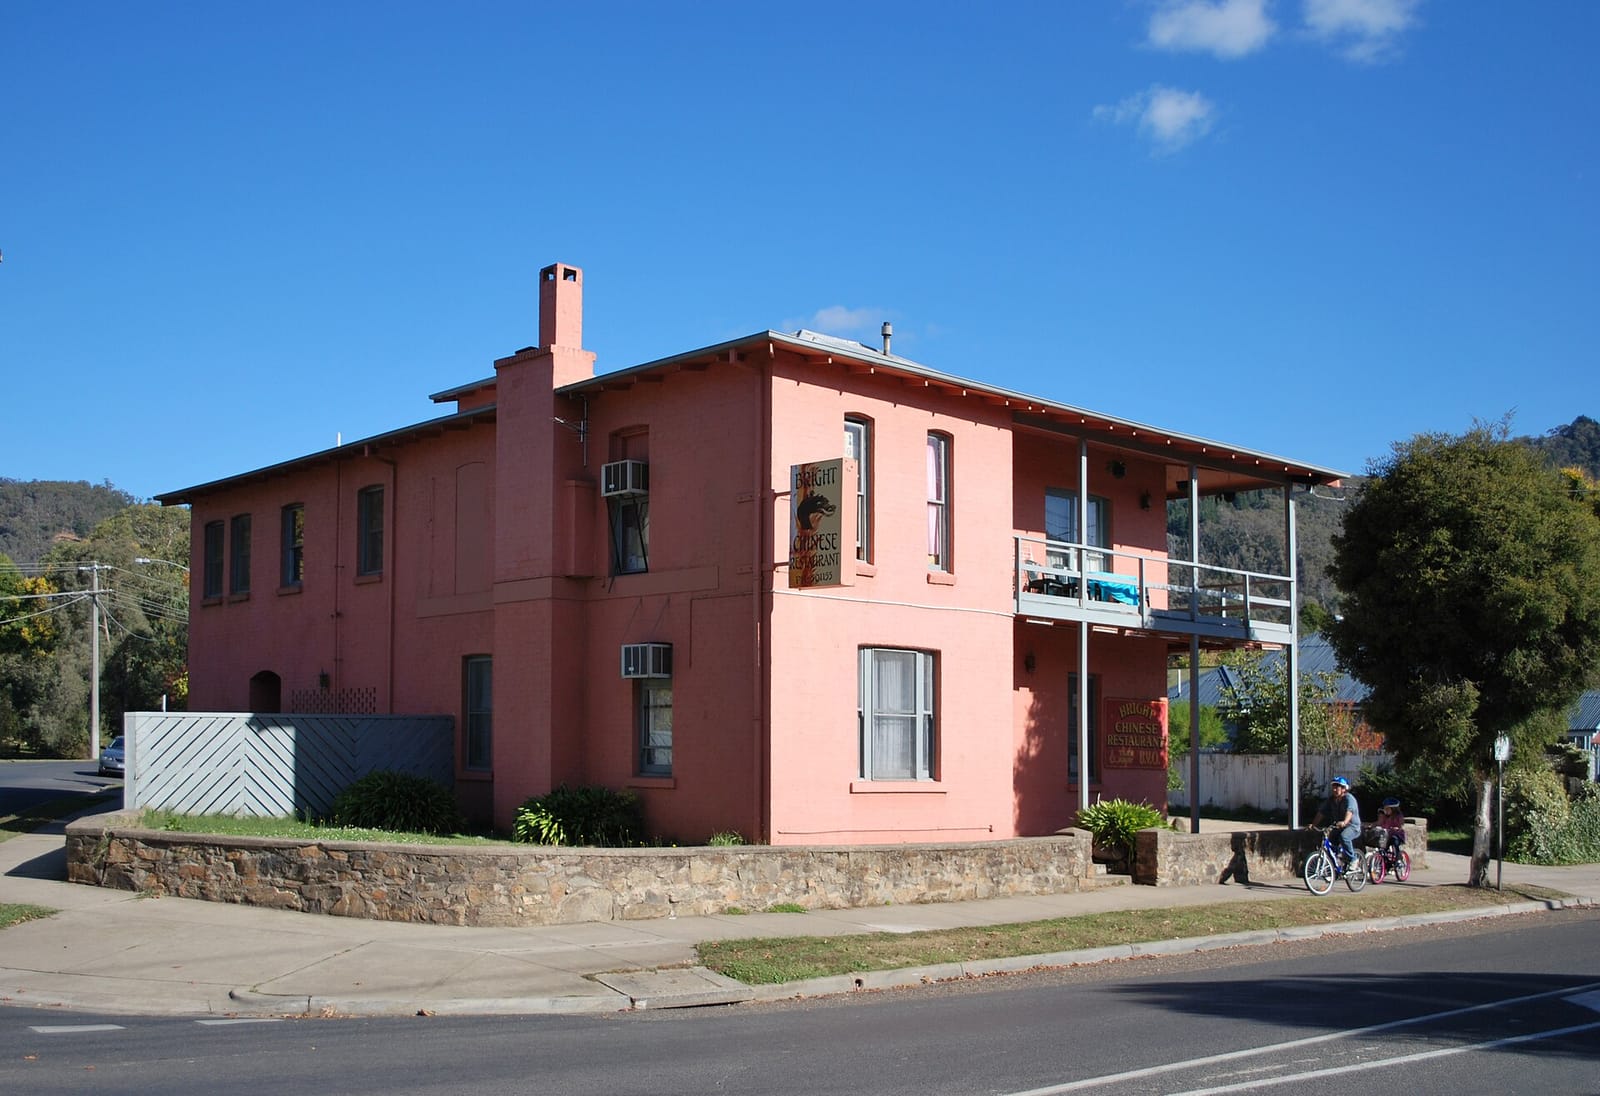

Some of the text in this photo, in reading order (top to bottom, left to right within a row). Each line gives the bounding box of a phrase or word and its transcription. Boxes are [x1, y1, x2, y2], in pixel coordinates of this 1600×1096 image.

[795, 468, 837, 490] BRIGHT
[794, 533, 838, 551] CHINESE
[789, 553, 839, 570] RESTAURANT
[1119, 702, 1155, 719] BRIGHT
[1115, 722, 1158, 734] CHINESE
[1107, 735, 1165, 747] RESTAURANT
